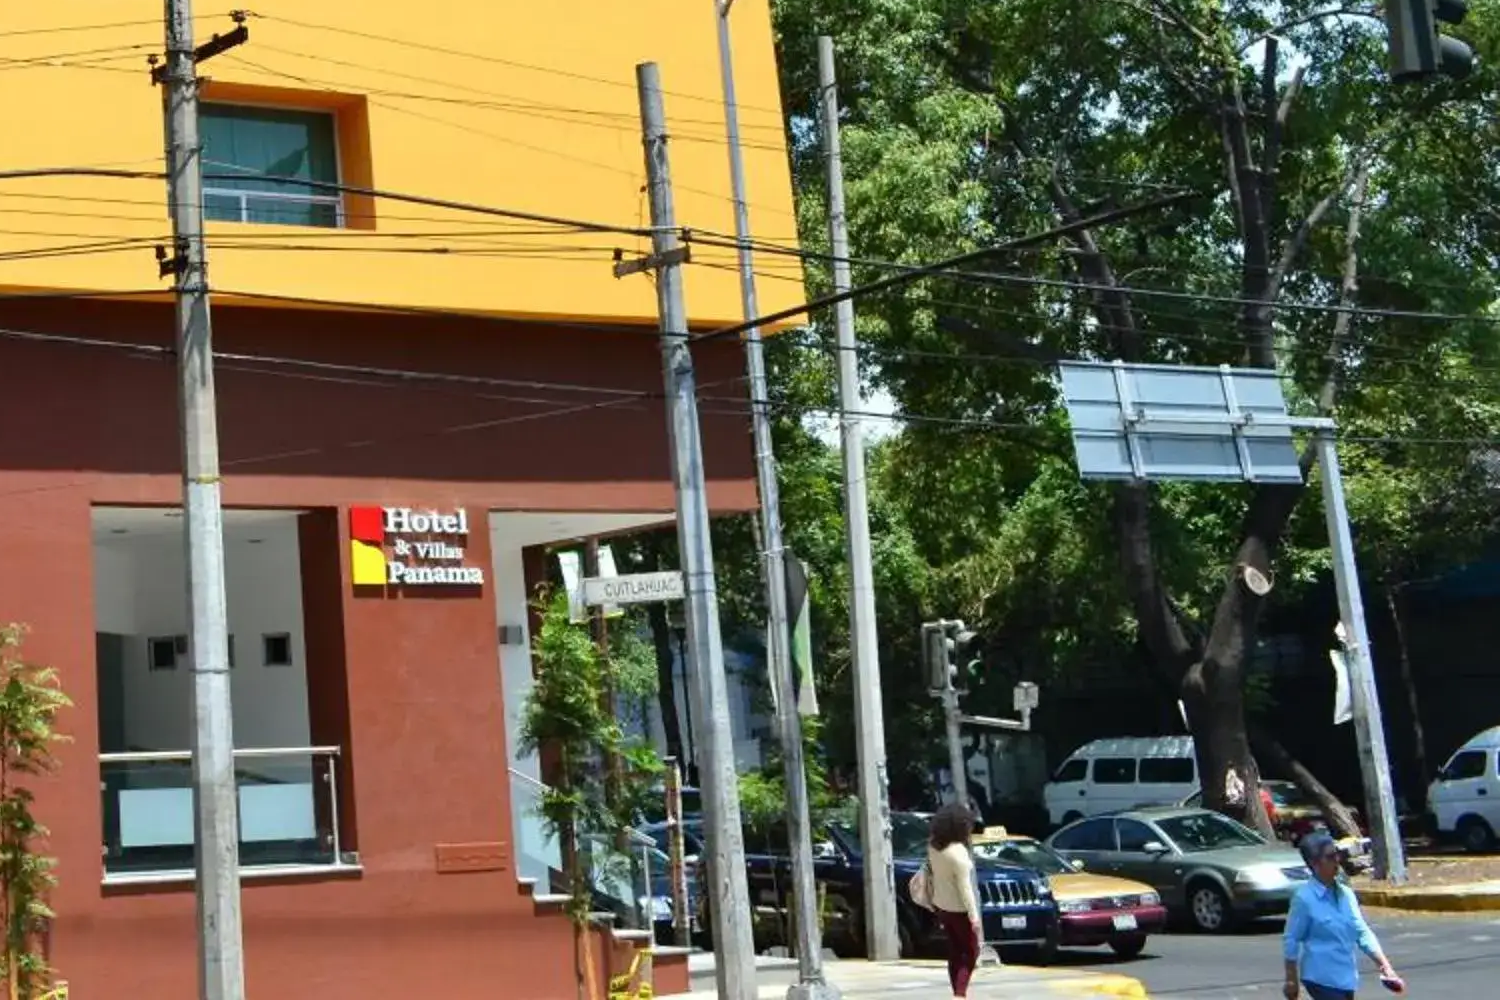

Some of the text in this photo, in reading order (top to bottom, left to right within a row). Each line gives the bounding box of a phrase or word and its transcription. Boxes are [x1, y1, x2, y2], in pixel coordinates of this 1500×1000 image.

[383, 507, 468, 534] Hotel
[395, 538, 464, 559] & Villas
[387, 560, 484, 585] Panama
[604, 577, 677, 597] CUITLAHUAC
